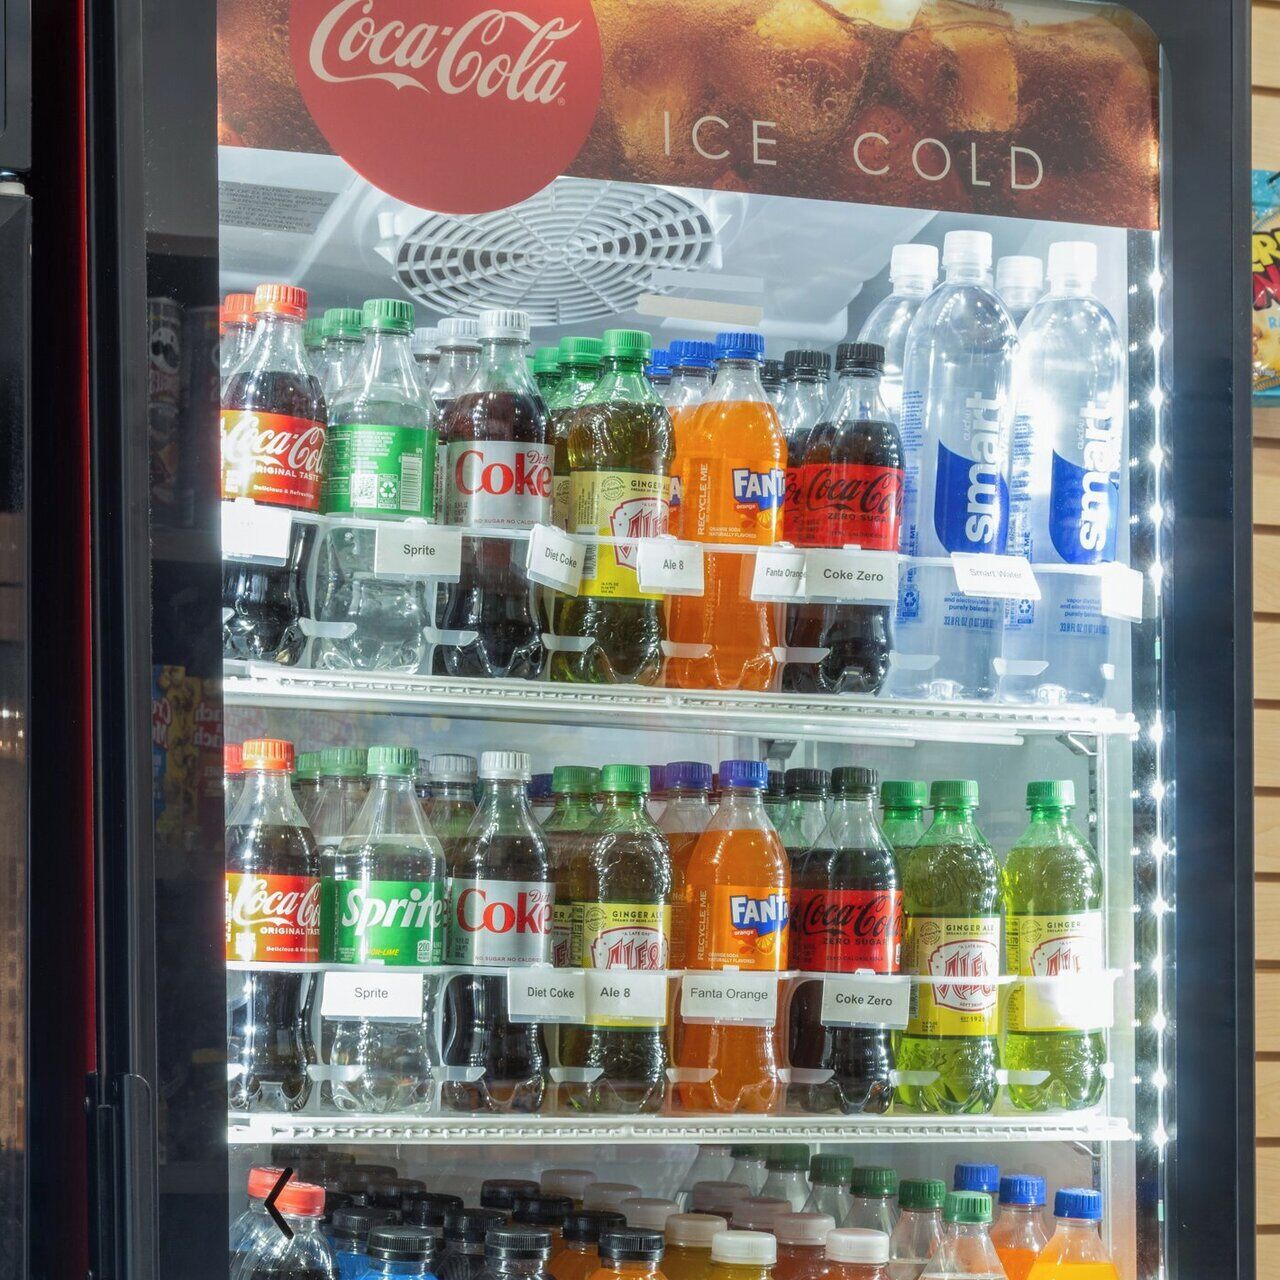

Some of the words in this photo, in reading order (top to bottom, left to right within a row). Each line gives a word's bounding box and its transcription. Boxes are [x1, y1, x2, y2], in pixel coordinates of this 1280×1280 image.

[308, 0, 578, 105] Coca-Cola
[664, 110, 778, 166] ICE
[853, 131, 1043, 191] COLD
[455, 449, 553, 498] Coke
[700, 464, 709, 482] ME
[965, 391, 1003, 545] smart
[1079, 400, 1113, 552] smart
[697, 484, 709, 536] RECYCLE
[403, 543, 435, 558] Sprite
[544, 546, 558, 561] Diet
[559, 551, 577, 569] Coke
[663, 559, 677, 570] Ale
[678, 559, 684, 570] 8
[766, 568, 784, 578] Fanta
[823, 568, 853, 581] Coke
[856, 570, 884, 582] Zero
[699, 890, 706, 905] ME
[342, 888, 443, 936] Sprite
[457, 887, 553, 934] Coke
[260, 926, 305, 935] ORIGINAL
[697, 906, 706, 961] RECYCLE
[354, 987, 388, 999] Sprite
[527, 986, 548, 998] Diet
[550, 987, 575, 999] Coke
[600, 986, 619, 998] Ale
[622, 986, 631, 998] 8
[690, 987, 723, 999] Fanta
[726, 988, 769, 1003] Orange
[835, 993, 865, 1006] Coke
[868, 994, 893, 1006] Zero
